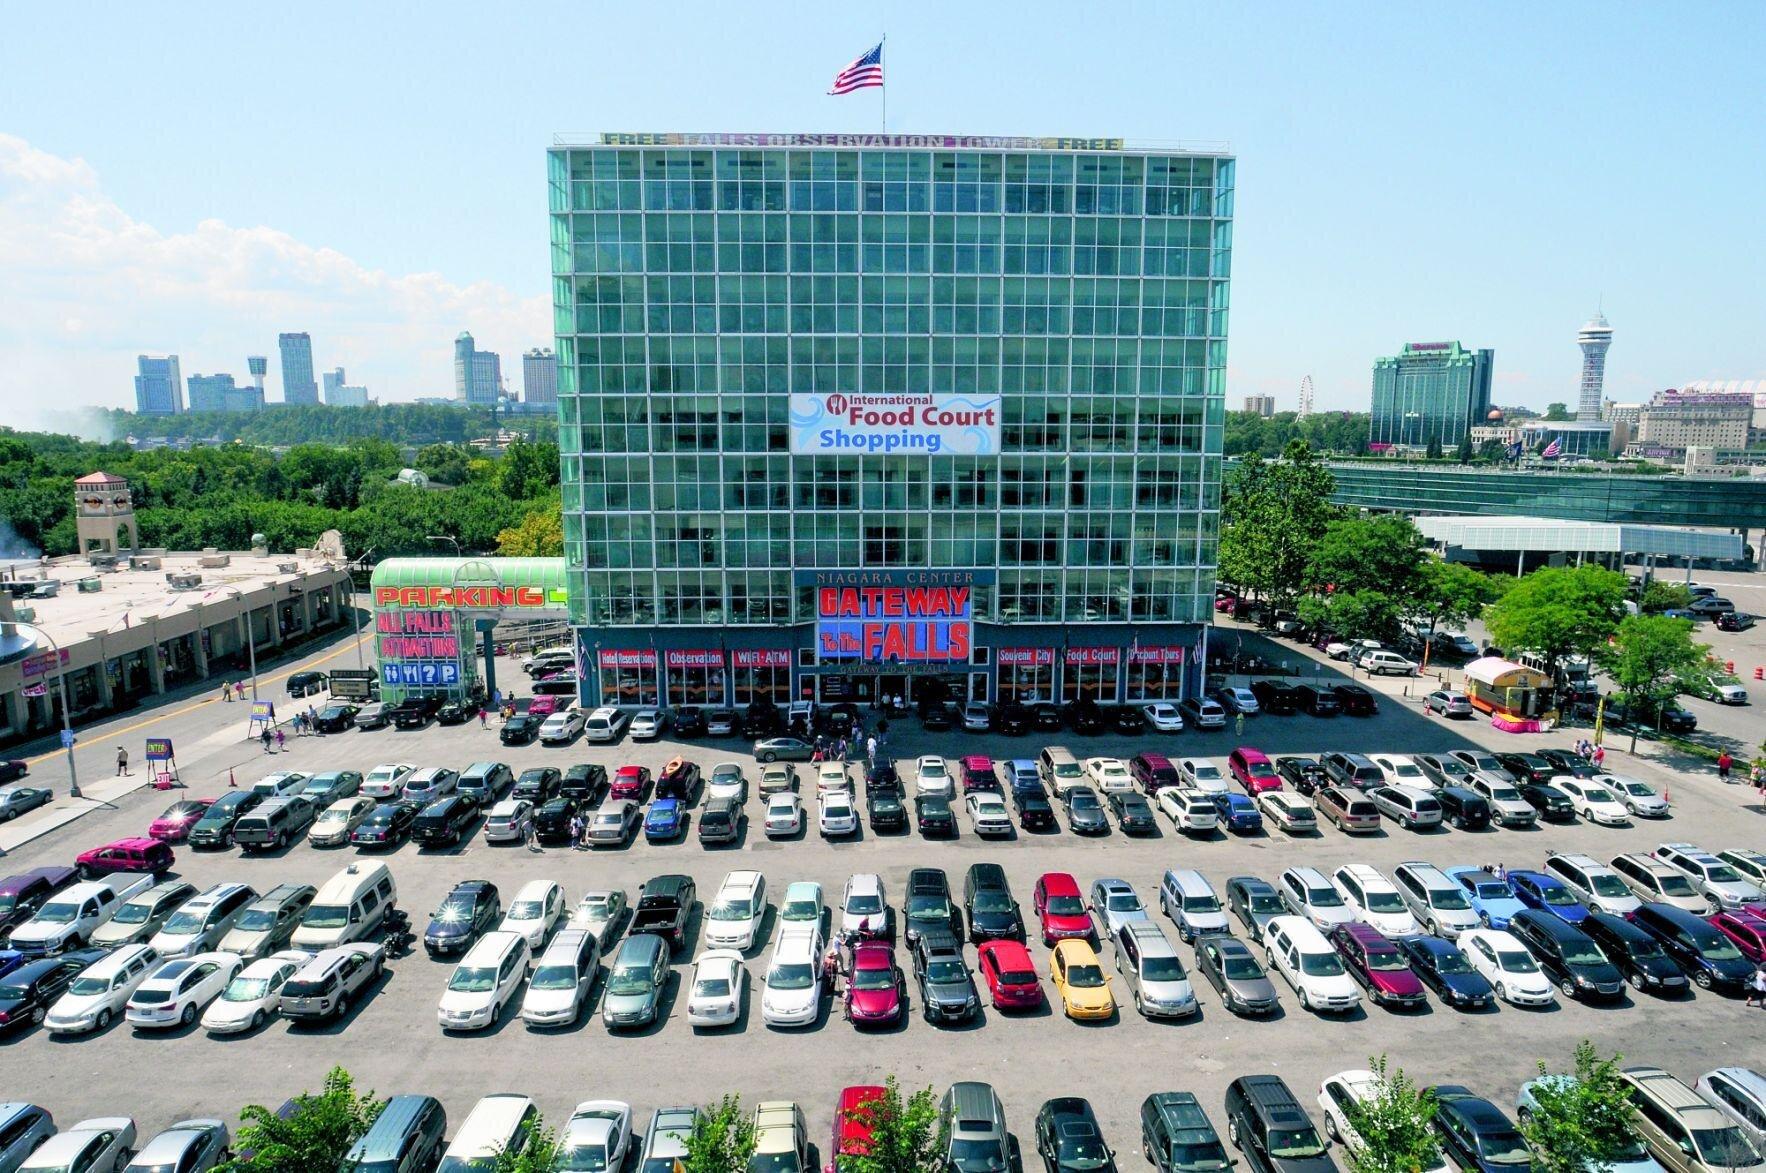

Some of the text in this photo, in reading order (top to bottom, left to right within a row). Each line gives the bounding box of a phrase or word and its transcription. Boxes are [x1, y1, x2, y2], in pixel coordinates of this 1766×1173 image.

[605, 133, 1121, 150] FREE FALLS OBSERVATION TOWER FREE
[850, 395, 933, 406] International
[850, 406, 995, 426] Food Court
[820, 429, 941, 452] Shopping
[816, 572, 974, 584] NIAGARA CENTER
[375, 586, 545, 607] PARKING
[819, 587, 970, 616] GATEWAY
[377, 611, 452, 633] ALL FALLS
[381, 637, 458, 658] ATTRACTIONS
[821, 631, 838, 652] To
[864, 622, 970, 660] FALLS
[602, 652, 617, 665] Hotel
[670, 651, 721, 664] Observation
[765, 651, 788, 664] ATM
[1000, 650, 1051, 664] Souvenir City
[1067, 649, 1116, 661] Food Court
[1129, 648, 1180, 660] Dscount Tours
[840, 665, 880, 674] GATEWAY
[147, 743, 165, 753] ENTER
[157, 774, 170, 784] EXIT
